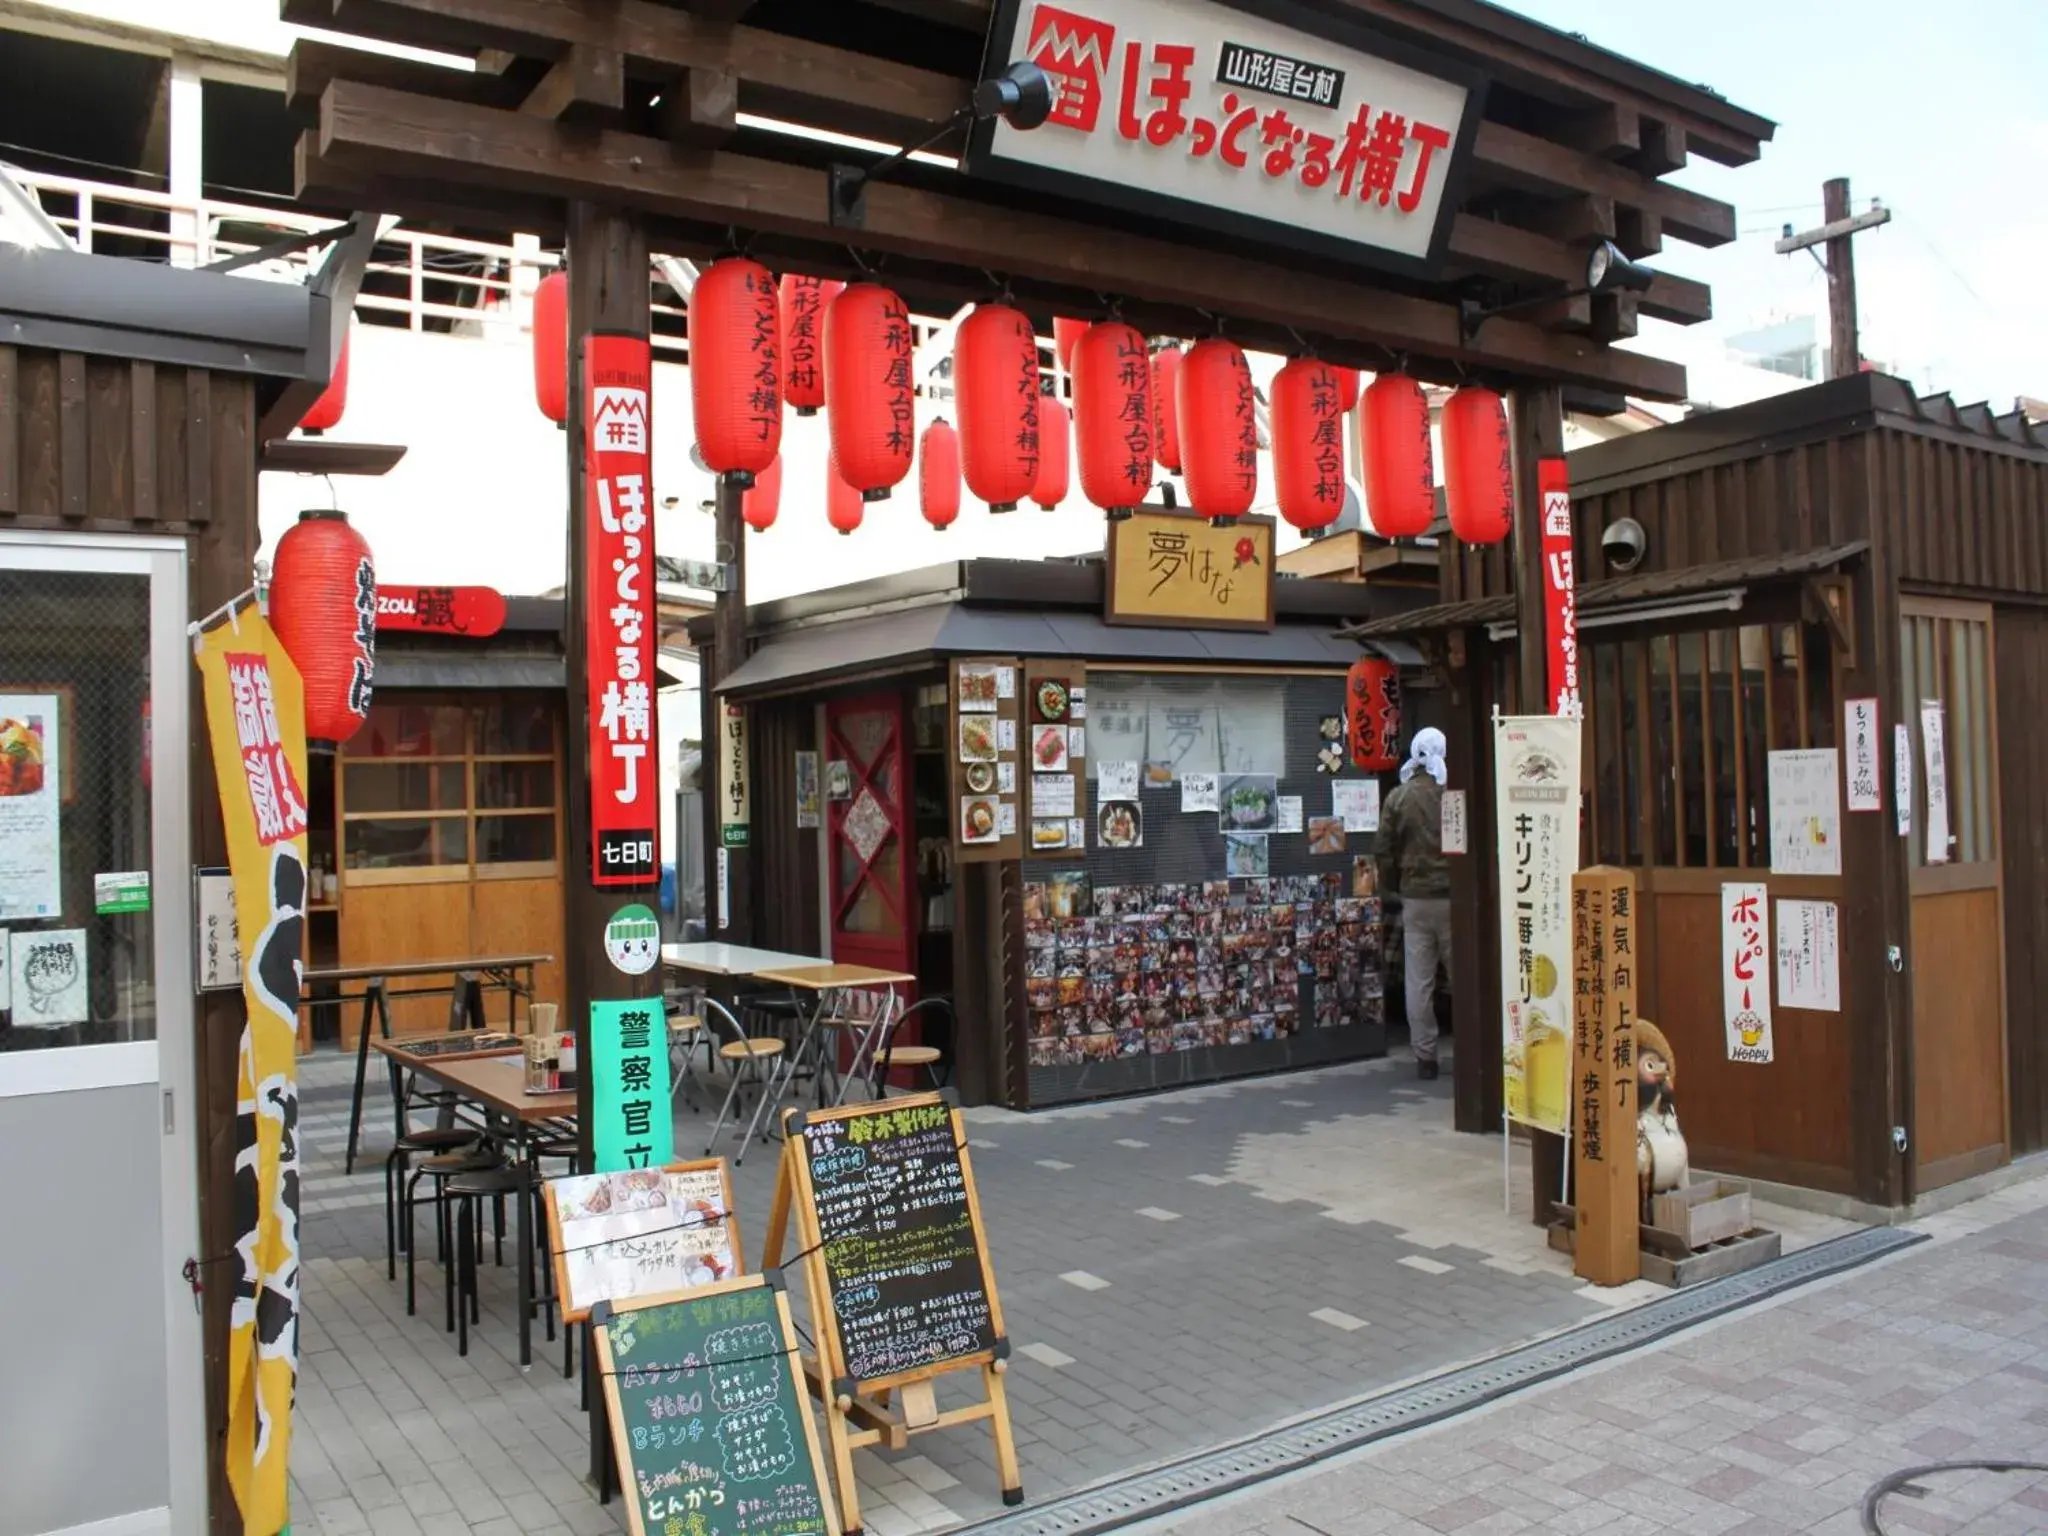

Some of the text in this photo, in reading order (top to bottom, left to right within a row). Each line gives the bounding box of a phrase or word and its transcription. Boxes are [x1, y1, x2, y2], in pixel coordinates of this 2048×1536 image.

[1117, 41, 1450, 214] ほっとなる横丁
[1225, 49, 1338, 103] 山形屋台村
[745, 271, 778, 441] ほっとなる横丁
[788, 277, 822, 390] 山形屋台村
[883, 297, 914, 458] 山形屋台村
[1117, 332, 1152, 487] 山形屋台村
[1311, 368, 1341, 503] 山形屋台村
[1149, 531, 1235, 605] 夢はな
[597, 474, 649, 803] ほっとなる横丁
[602, 841, 653, 864] 七日町
[1515, 813, 1533, 1003] キリン一番搾り
[1574, 888, 1591, 1058] 運気向上致します
[1612, 886, 1632, 1107] 運気向上横丁
[1732, 888, 1763, 1010] ホッピー
[848, 1107, 948, 1145] 鈴木製作所
[632, 1418, 705, 1450] Bランチ
[648, 1486, 725, 1520] とんかつ
